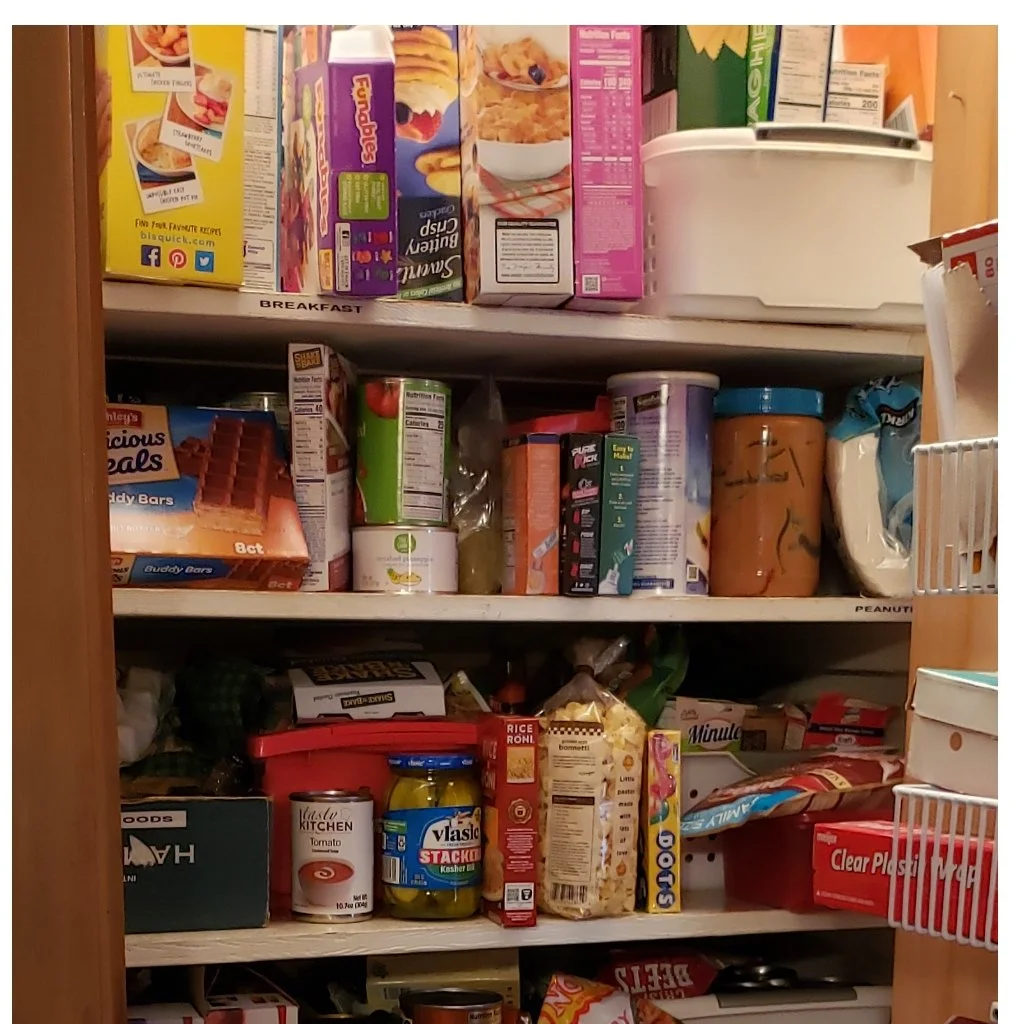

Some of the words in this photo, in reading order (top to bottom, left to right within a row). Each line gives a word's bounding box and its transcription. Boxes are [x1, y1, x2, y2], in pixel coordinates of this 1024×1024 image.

[135, 218, 149, 229] FIND
[419, 216, 459, 238] Crisp
[140, 231, 216, 248] bisquick.com
[405, 232, 459, 256] Buttery
[259, 299, 364, 315] BREAKFAST
[138, 493, 175, 507] Bars
[234, 541, 266, 556] 8ct
[144, 563, 184, 576] Buddy
[184, 564, 214, 576] Bars
[506, 723, 534, 735] RICE
[687, 722, 743, 745] Minute
[299, 820, 354, 833] KITCHEN
[309, 837, 342, 848] Tomato
[830, 848, 870, 874] Clear
[656, 830, 677, 909] DOTS
[614, 962, 694, 994] BEETS
